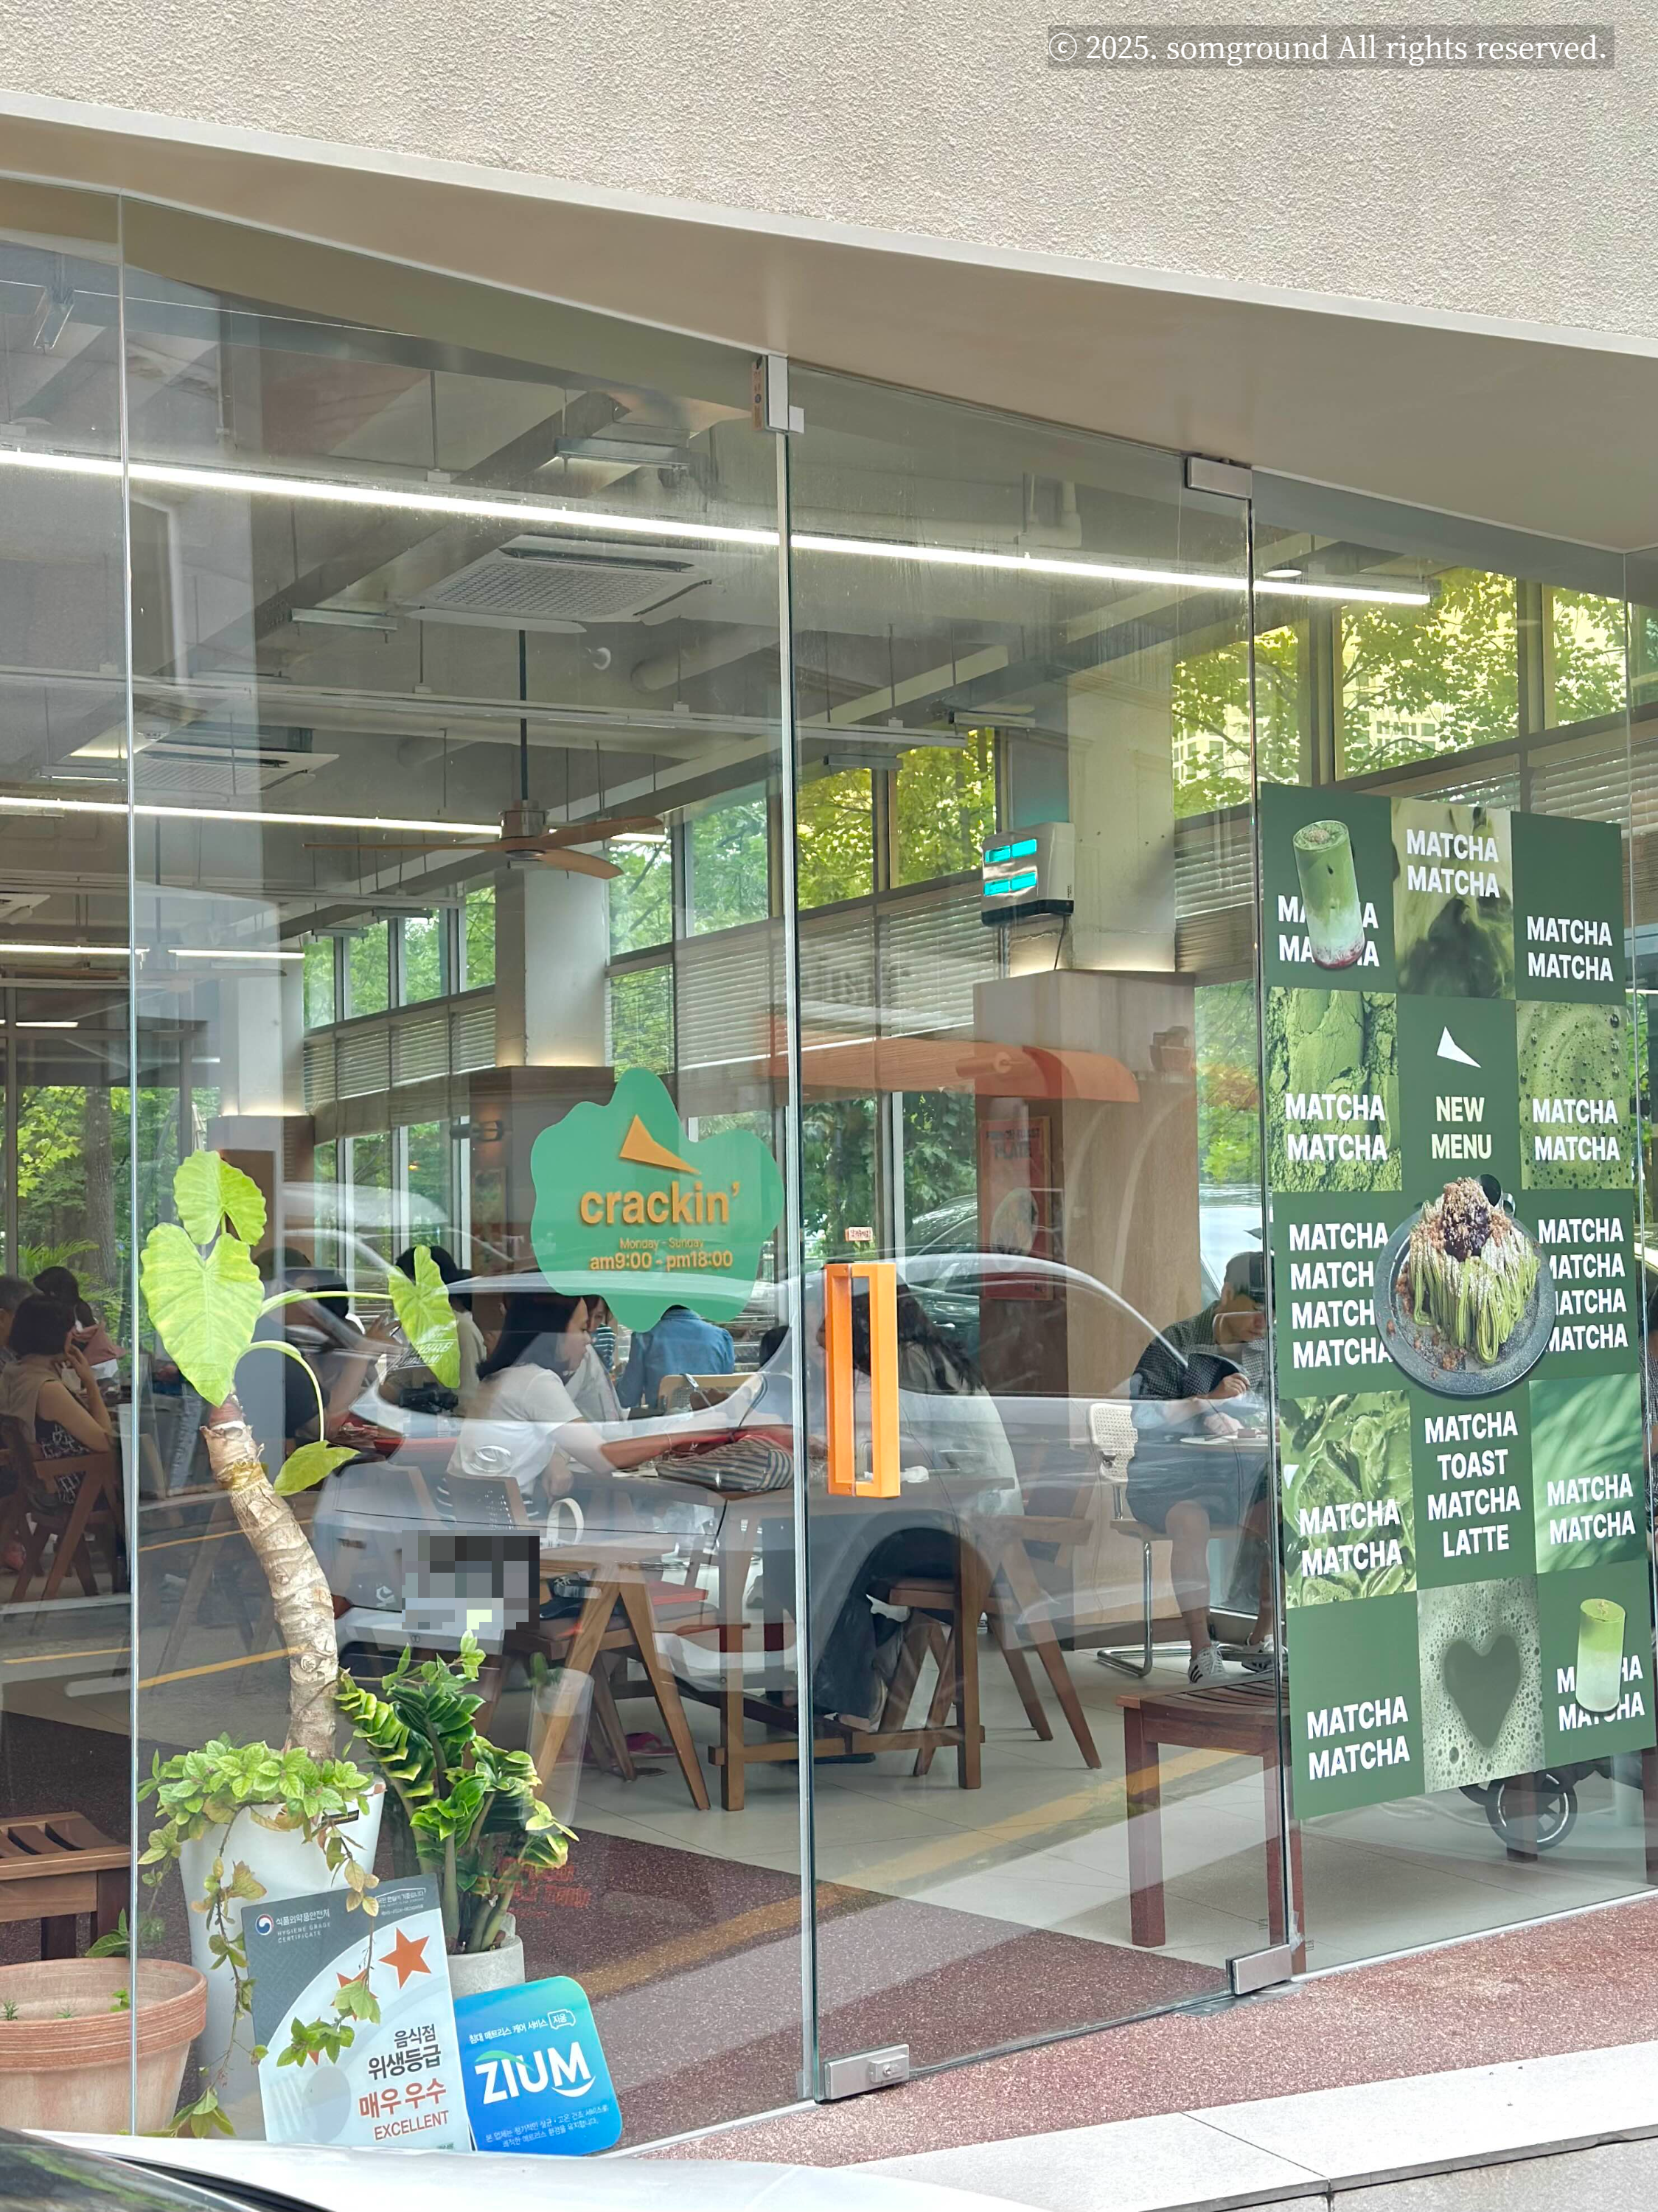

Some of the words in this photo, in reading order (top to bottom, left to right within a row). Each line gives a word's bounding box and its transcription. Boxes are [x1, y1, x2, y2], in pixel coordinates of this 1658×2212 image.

[1407, 829, 1499, 863] MATCHA
[1407, 865, 1500, 898] MATCHA
[1527, 916, 1613, 946] MATCHA
[1279, 934, 1379, 967] MAA
[1528, 952, 1614, 981] MATCHA
[1285, 1093, 1386, 1121] MATCHA
[1435, 1096, 1485, 1122] NEW
[1532, 1098, 1618, 1124] MATCHA
[1287, 1133, 1388, 1161] MATCHA
[1431, 1133, 1492, 1160] MENU
[1534, 1135, 1620, 1161] MATCHA
[579, 1181, 740, 1225] crackin'
[619, 1237, 659, 1251] Monday
[668, 1237, 704, 1251] Sunday
[1289, 1222, 1389, 1251] MATCHA
[1538, 1217, 1624, 1244] MATCHA
[589, 1252, 652, 1270] am9:00
[666, 1250, 734, 1272] pm18:00
[1290, 1260, 1374, 1290] MATCH
[1292, 1298, 1376, 1329] MATCH
[1555, 1288, 1627, 1315] ATCHA
[1424, 1411, 1518, 1444] MATCHA
[1437, 1448, 1508, 1481] TOAST
[1427, 1485, 1522, 1520] MATCHA
[1547, 1473, 1634, 1506] MATCHA
[1300, 1498, 1402, 1535] MATCHA
[1549, 1510, 1636, 1545] MATCHA
[1443, 1524, 1510, 1557] LATTE
[1302, 1539, 1403, 1577] MATCHA
[1557, 1655, 1643, 1694] MHA
[1307, 1696, 1409, 1739] MATCHA
[1309, 1735, 1410, 1781] MATCHA
[276, 1908, 330, 1926] 식품의약품안전처
[277, 1927, 306, 1936] HYGIENE
[309, 1921, 331, 1930] GRADE
[278, 1930, 321, 1943] CERTIFICATE
[394, 2023, 436, 2049] 음식점
[469, 2033, 484, 2045] 침대
[484, 2026, 512, 2040] 매트리스
[512, 2023, 527, 2034] 케어
[528, 2019, 548, 2029] 서비스
[368, 2043, 442, 2081] 위생등급
[474, 2041, 592, 2105] ZIUM
[359, 2088, 402, 2118] 매우
[405, 2078, 447, 2110] 우수
[375, 2110, 449, 2140] EXCELLENT
[515, 2121, 539, 2135] 정기적인
[557, 2114, 571, 2124] 고온
[522, 2132, 547, 2143] 매트리스
